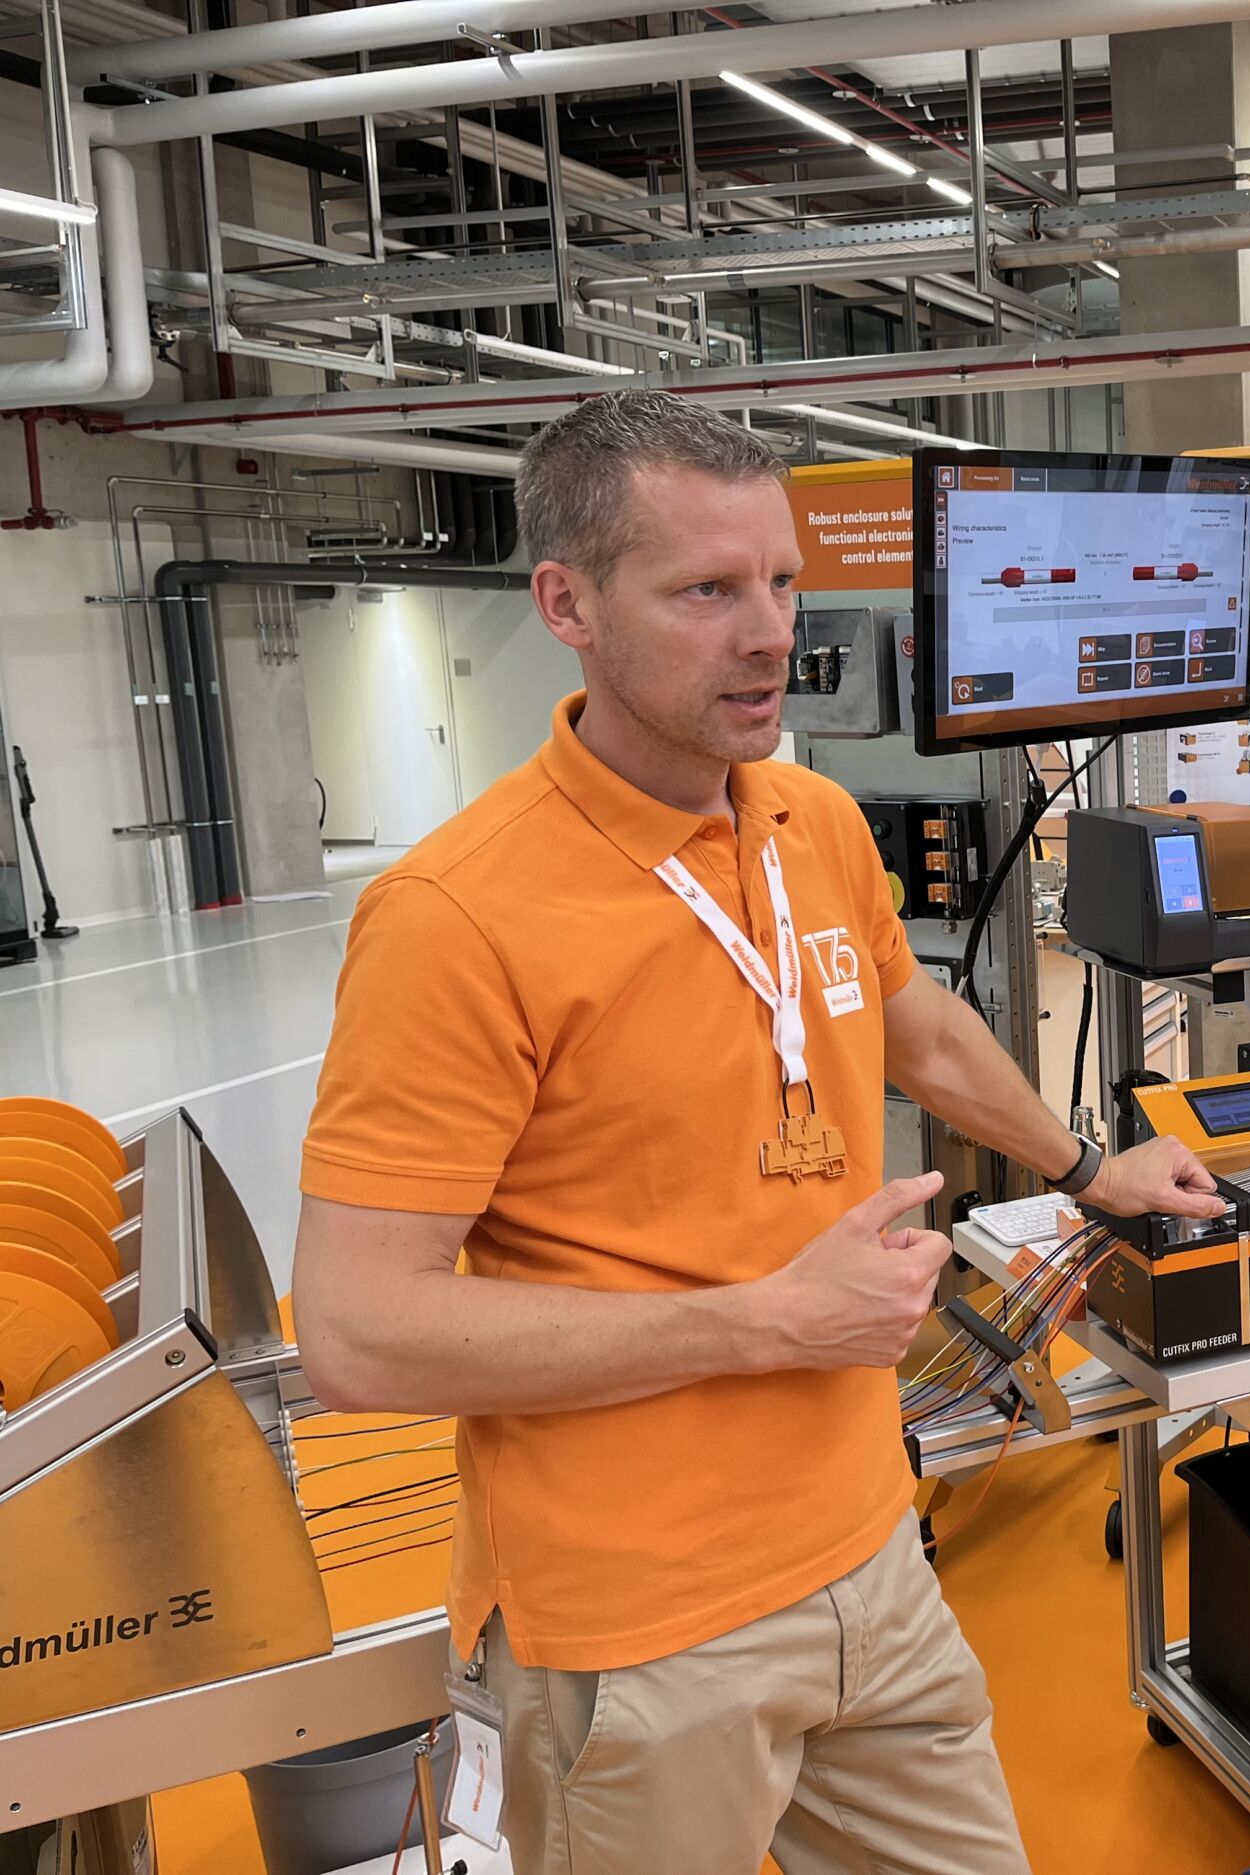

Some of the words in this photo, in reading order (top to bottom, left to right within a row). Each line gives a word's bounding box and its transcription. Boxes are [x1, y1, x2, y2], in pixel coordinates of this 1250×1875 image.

[808, 511, 841, 526] Robust
[843, 509, 889, 524] enclosure
[952, 525, 970, 533] Wiring
[970, 524, 1007, 532] characteristics
[819, 529, 867, 545] functional
[952, 537, 974, 545] Preview
[841, 549, 875, 564] control
[731, 940, 776, 997] Weidmüller
[785, 930, 798, 998] Weidmüller
[1137, 1087, 1162, 1096] CUTFIX
[1162, 1083, 1178, 1092] PRO
[1162, 1342, 1190, 1358] CUTFIX
[1191, 1339, 1208, 1351] PRO
[1209, 1332, 1238, 1347] FEEDER
[0, 1611, 158, 1669] dmüller
